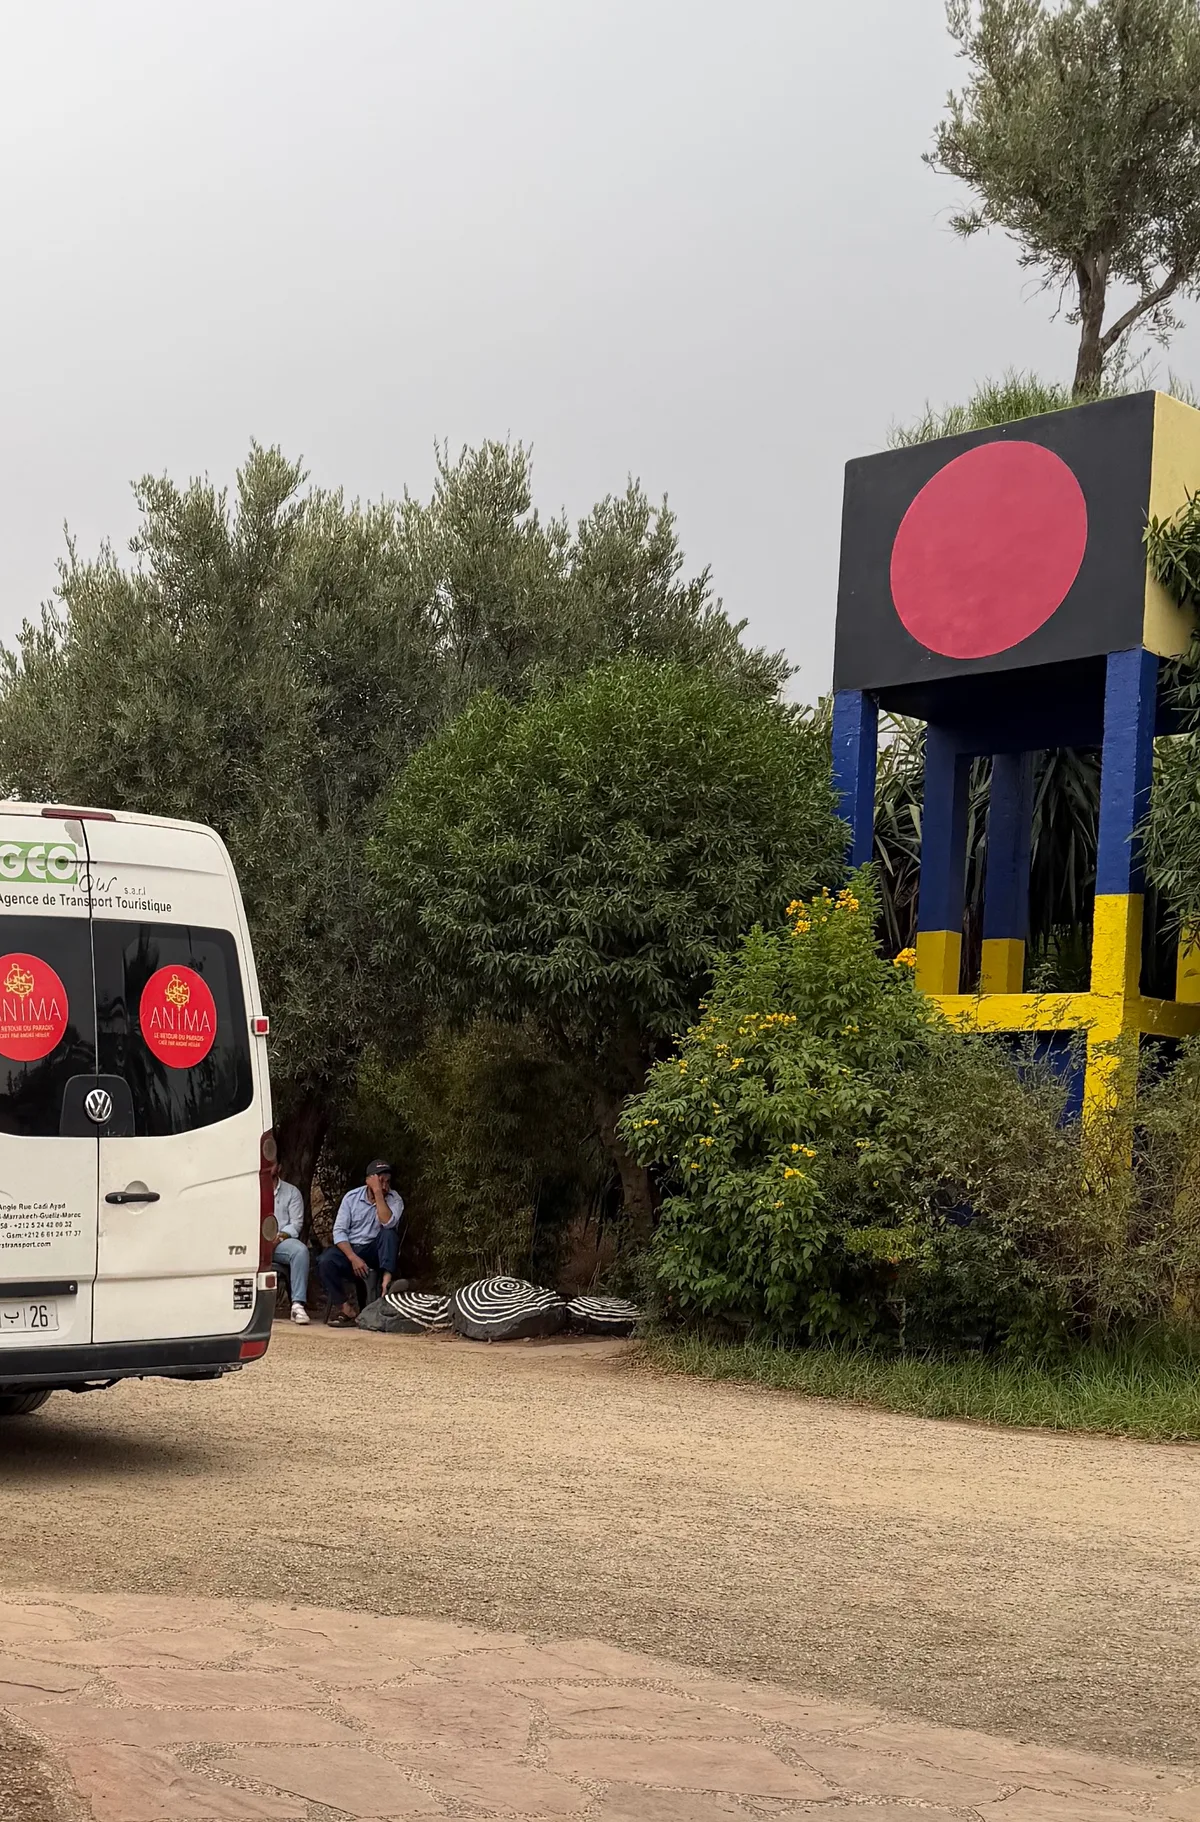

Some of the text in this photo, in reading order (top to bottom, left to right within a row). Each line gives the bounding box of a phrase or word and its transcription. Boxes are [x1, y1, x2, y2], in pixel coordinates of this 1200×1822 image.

[42, 893, 56, 905] de
[59, 893, 113, 909] Transport
[115, 895, 172, 913] Touristique
[150, 1006, 211, 1032] ANIMA
[228, 1245, 247, 1255] TDI
[4, 1311, 20, 1324] ب
[30, 1305, 49, 1328] 26
